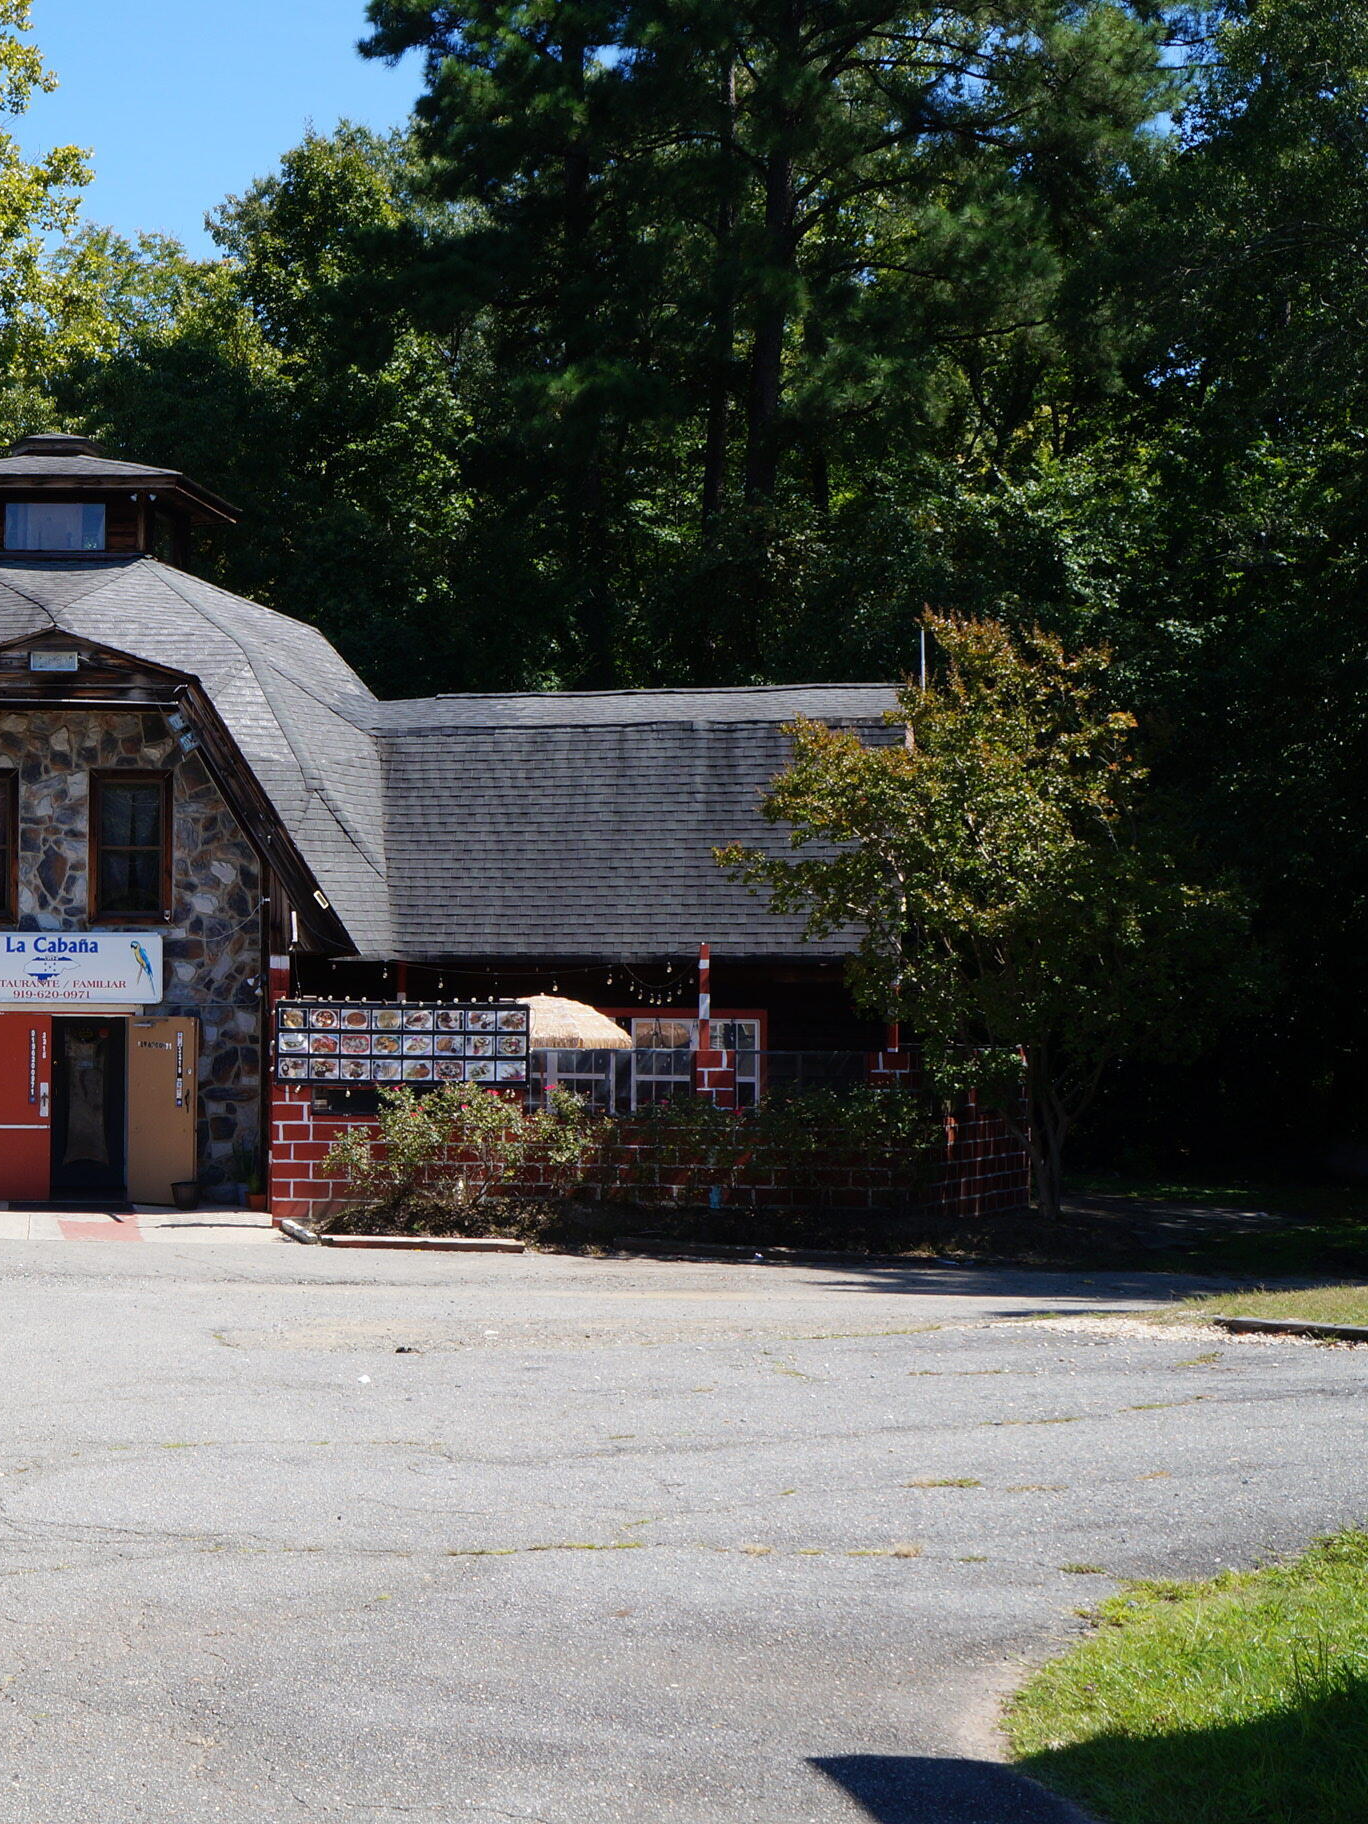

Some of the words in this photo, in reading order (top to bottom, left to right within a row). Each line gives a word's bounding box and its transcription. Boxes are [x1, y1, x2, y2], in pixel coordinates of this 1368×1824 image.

[6, 936, 26, 953] La
[33, 936, 99, 953] Cabaña
[72, 979, 127, 989] FAMILIAR
[13, 990, 91, 999] 919-620-0971
